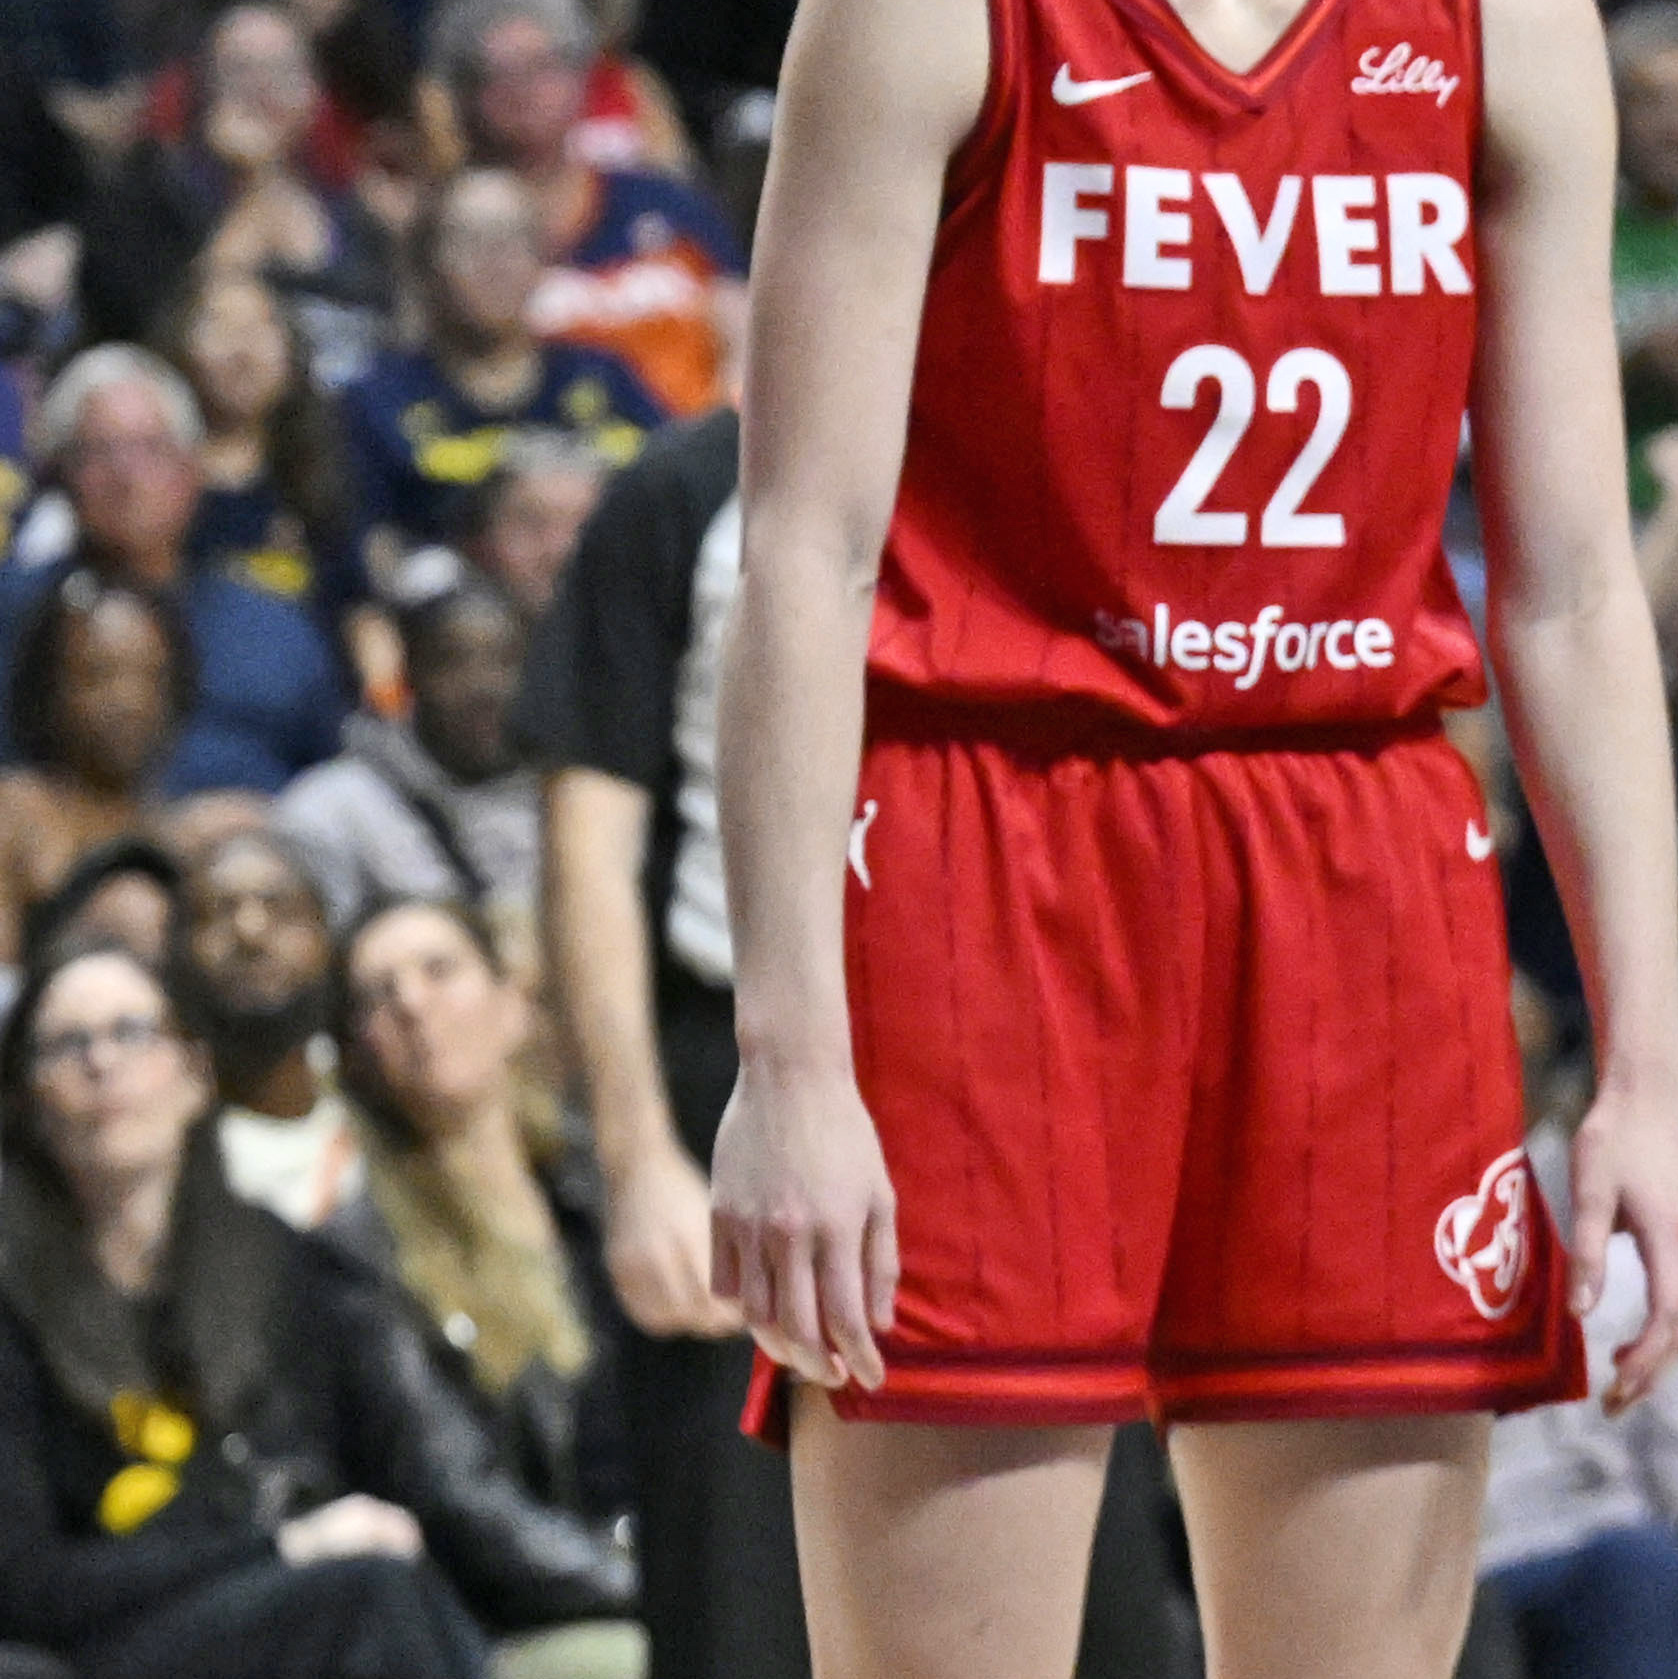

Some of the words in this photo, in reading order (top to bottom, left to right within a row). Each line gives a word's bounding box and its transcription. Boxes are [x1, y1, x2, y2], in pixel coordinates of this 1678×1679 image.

[1351, 41, 1461, 110] Lilly
[1037, 160, 1474, 297] FEVER
[1153, 343, 1354, 548] 22
